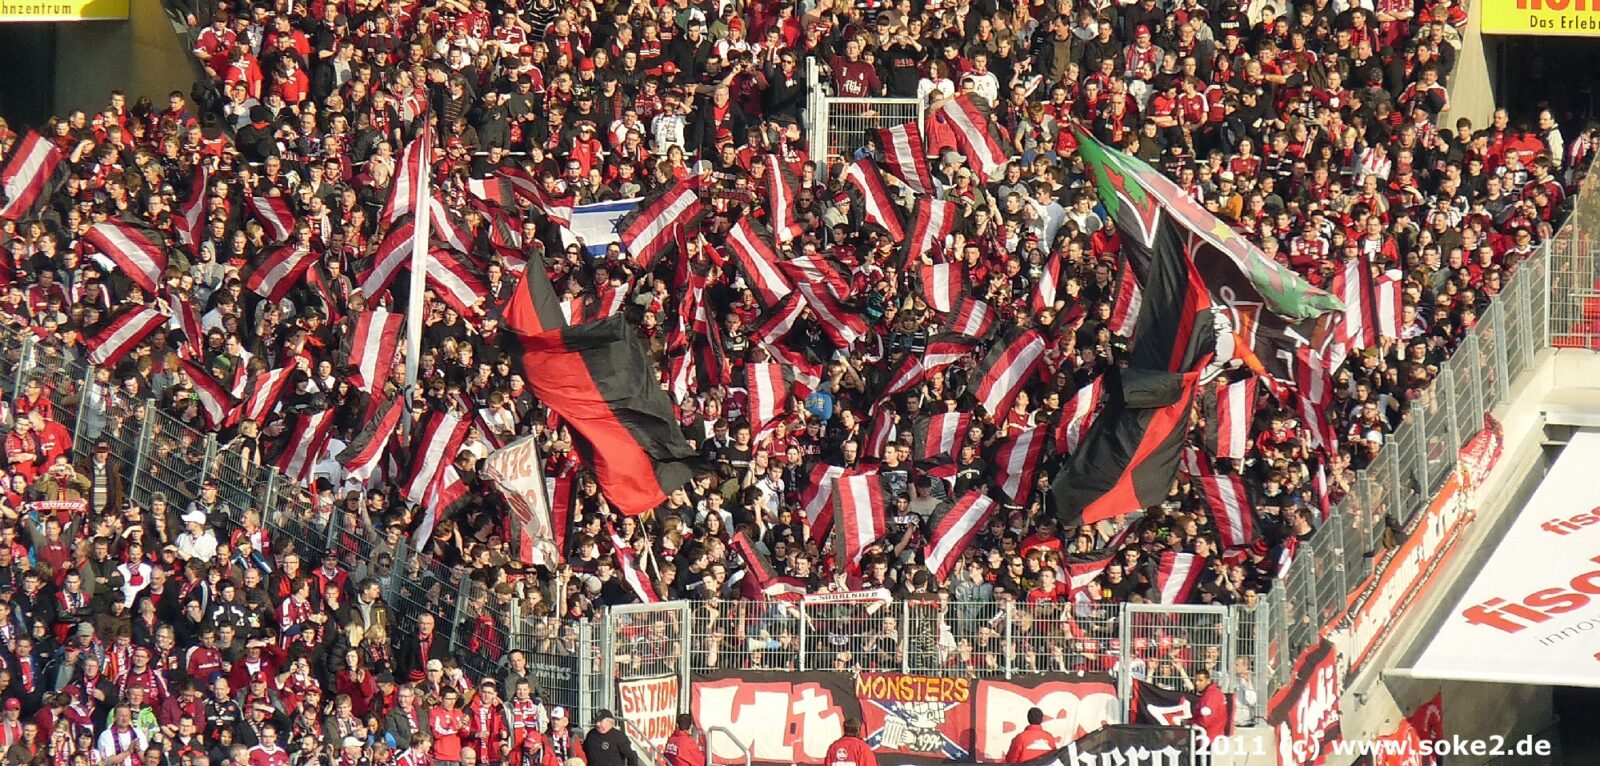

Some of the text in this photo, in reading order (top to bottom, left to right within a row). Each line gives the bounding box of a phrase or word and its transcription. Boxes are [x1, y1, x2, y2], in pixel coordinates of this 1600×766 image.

[2, 2, 72, 14] hnzentrum
[1530, 15, 1600, 29] Das Erleb
[856, 675, 970, 702] MONSTERS
